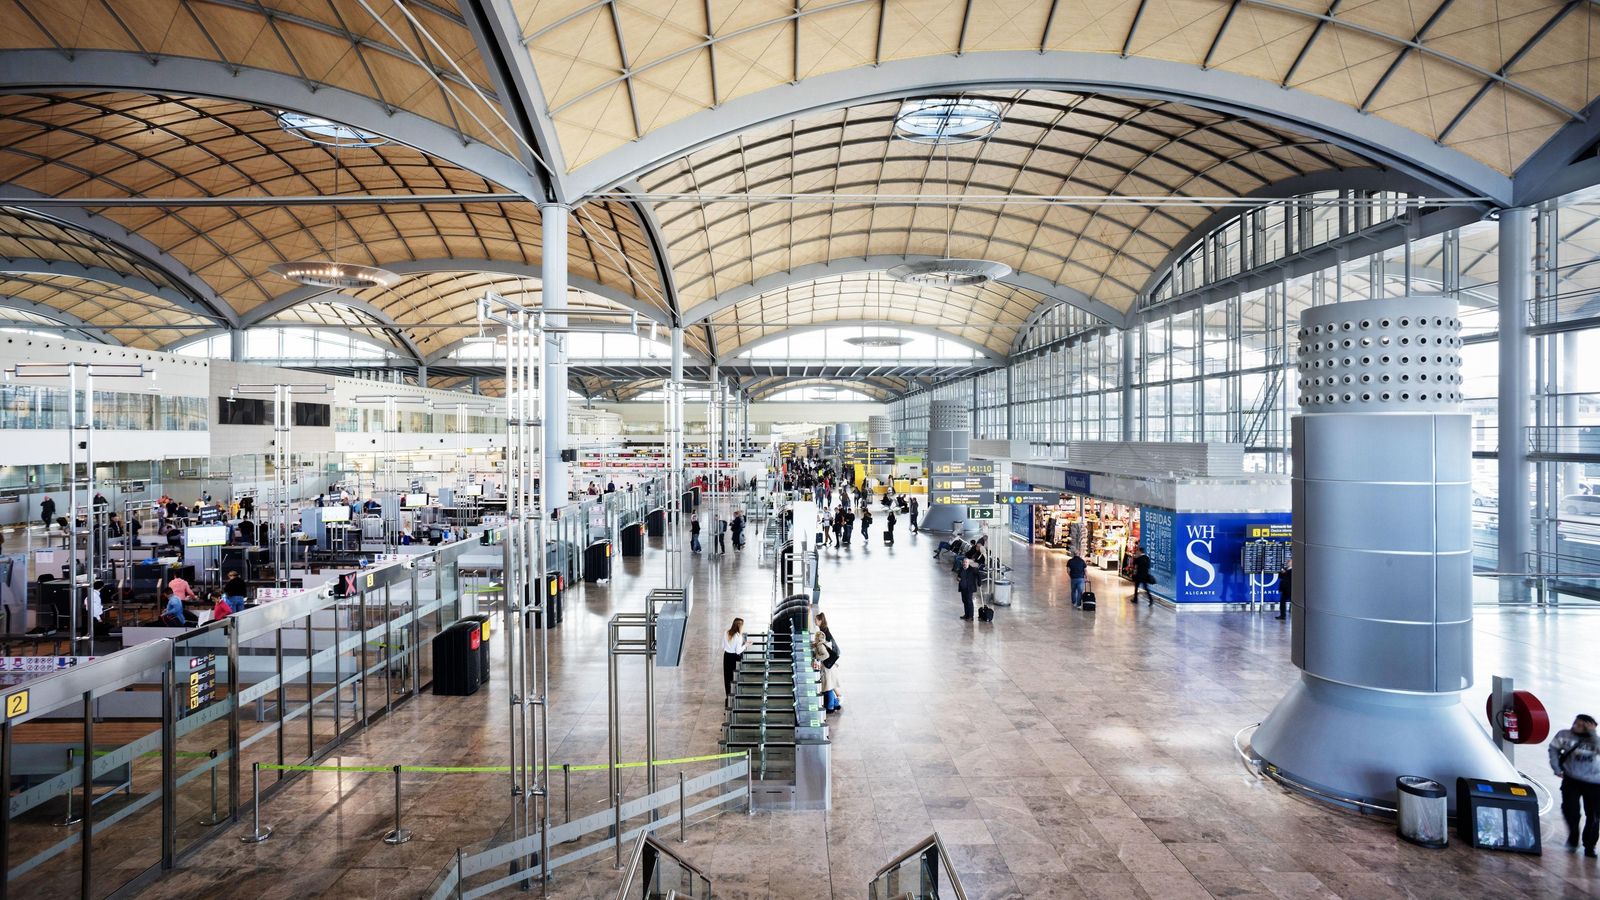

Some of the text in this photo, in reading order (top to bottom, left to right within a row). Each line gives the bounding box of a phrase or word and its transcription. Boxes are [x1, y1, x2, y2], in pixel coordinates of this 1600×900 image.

[1145, 511, 1172, 527] BEBIDAS
[1186, 525, 1216, 539] WH
[1185, 539, 1216, 588] S
[12, 695, 22, 714] 2
